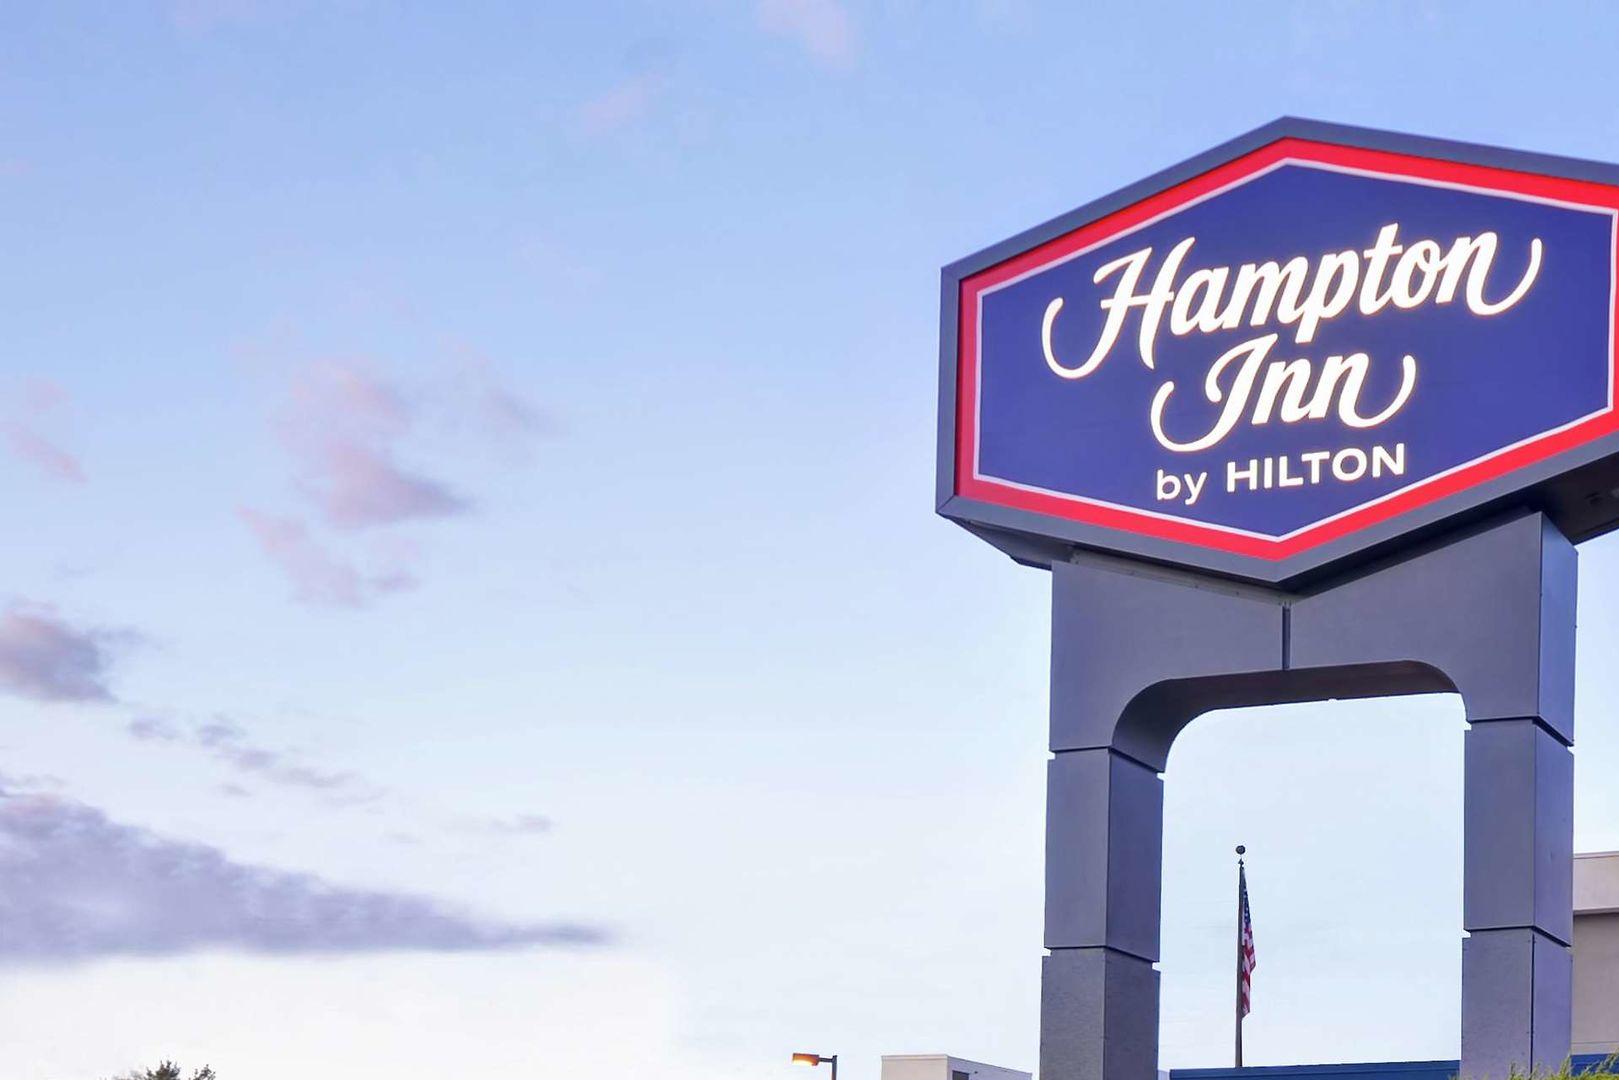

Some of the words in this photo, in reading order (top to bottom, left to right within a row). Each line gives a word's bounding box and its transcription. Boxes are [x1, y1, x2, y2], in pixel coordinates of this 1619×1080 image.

[1041, 222, 1544, 380] Hampton
[1150, 332, 1417, 453] Inn
[1156, 469, 1208, 506] by
[1226, 442, 1405, 493] HILTON
